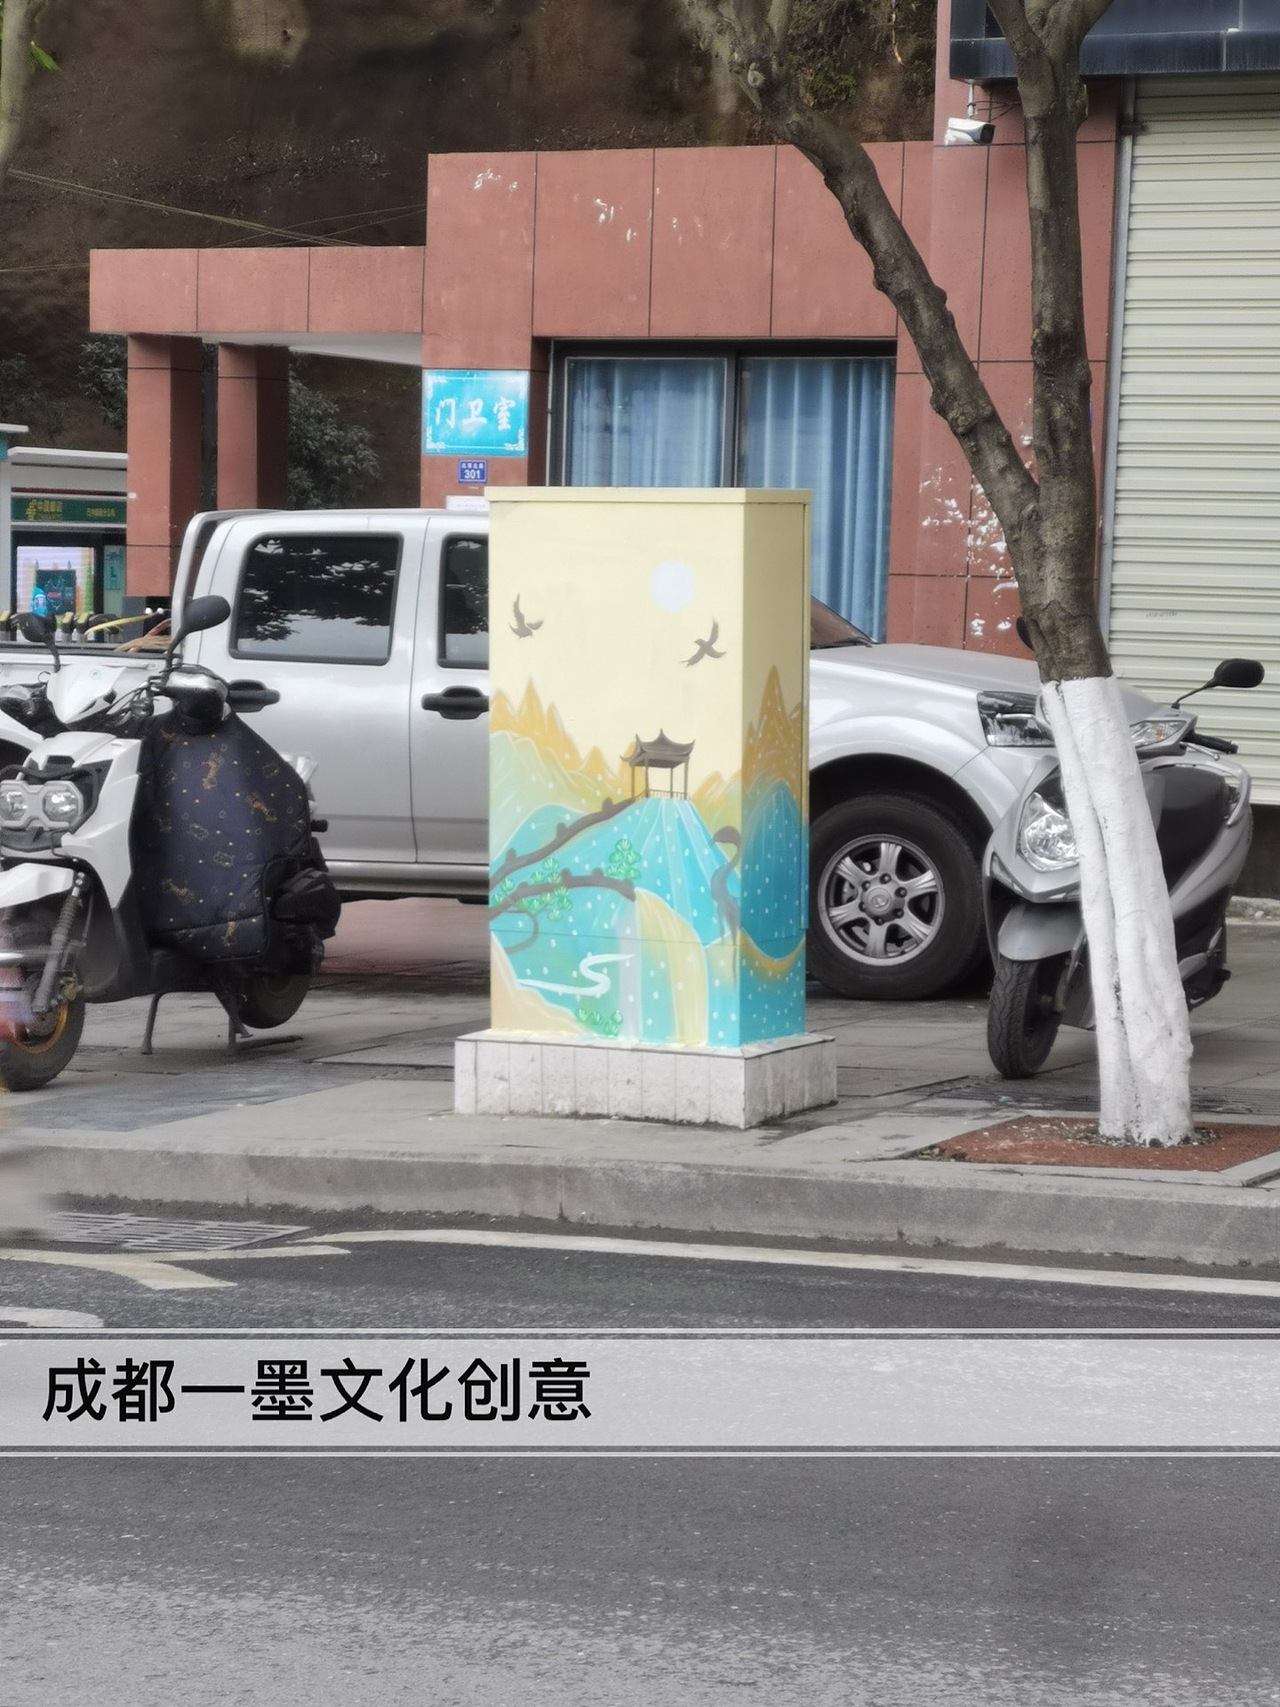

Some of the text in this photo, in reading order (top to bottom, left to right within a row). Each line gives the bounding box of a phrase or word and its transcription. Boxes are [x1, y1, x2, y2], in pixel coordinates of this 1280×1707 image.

[435, 397, 516, 431] 门卫室
[464, 469, 481, 479] 301
